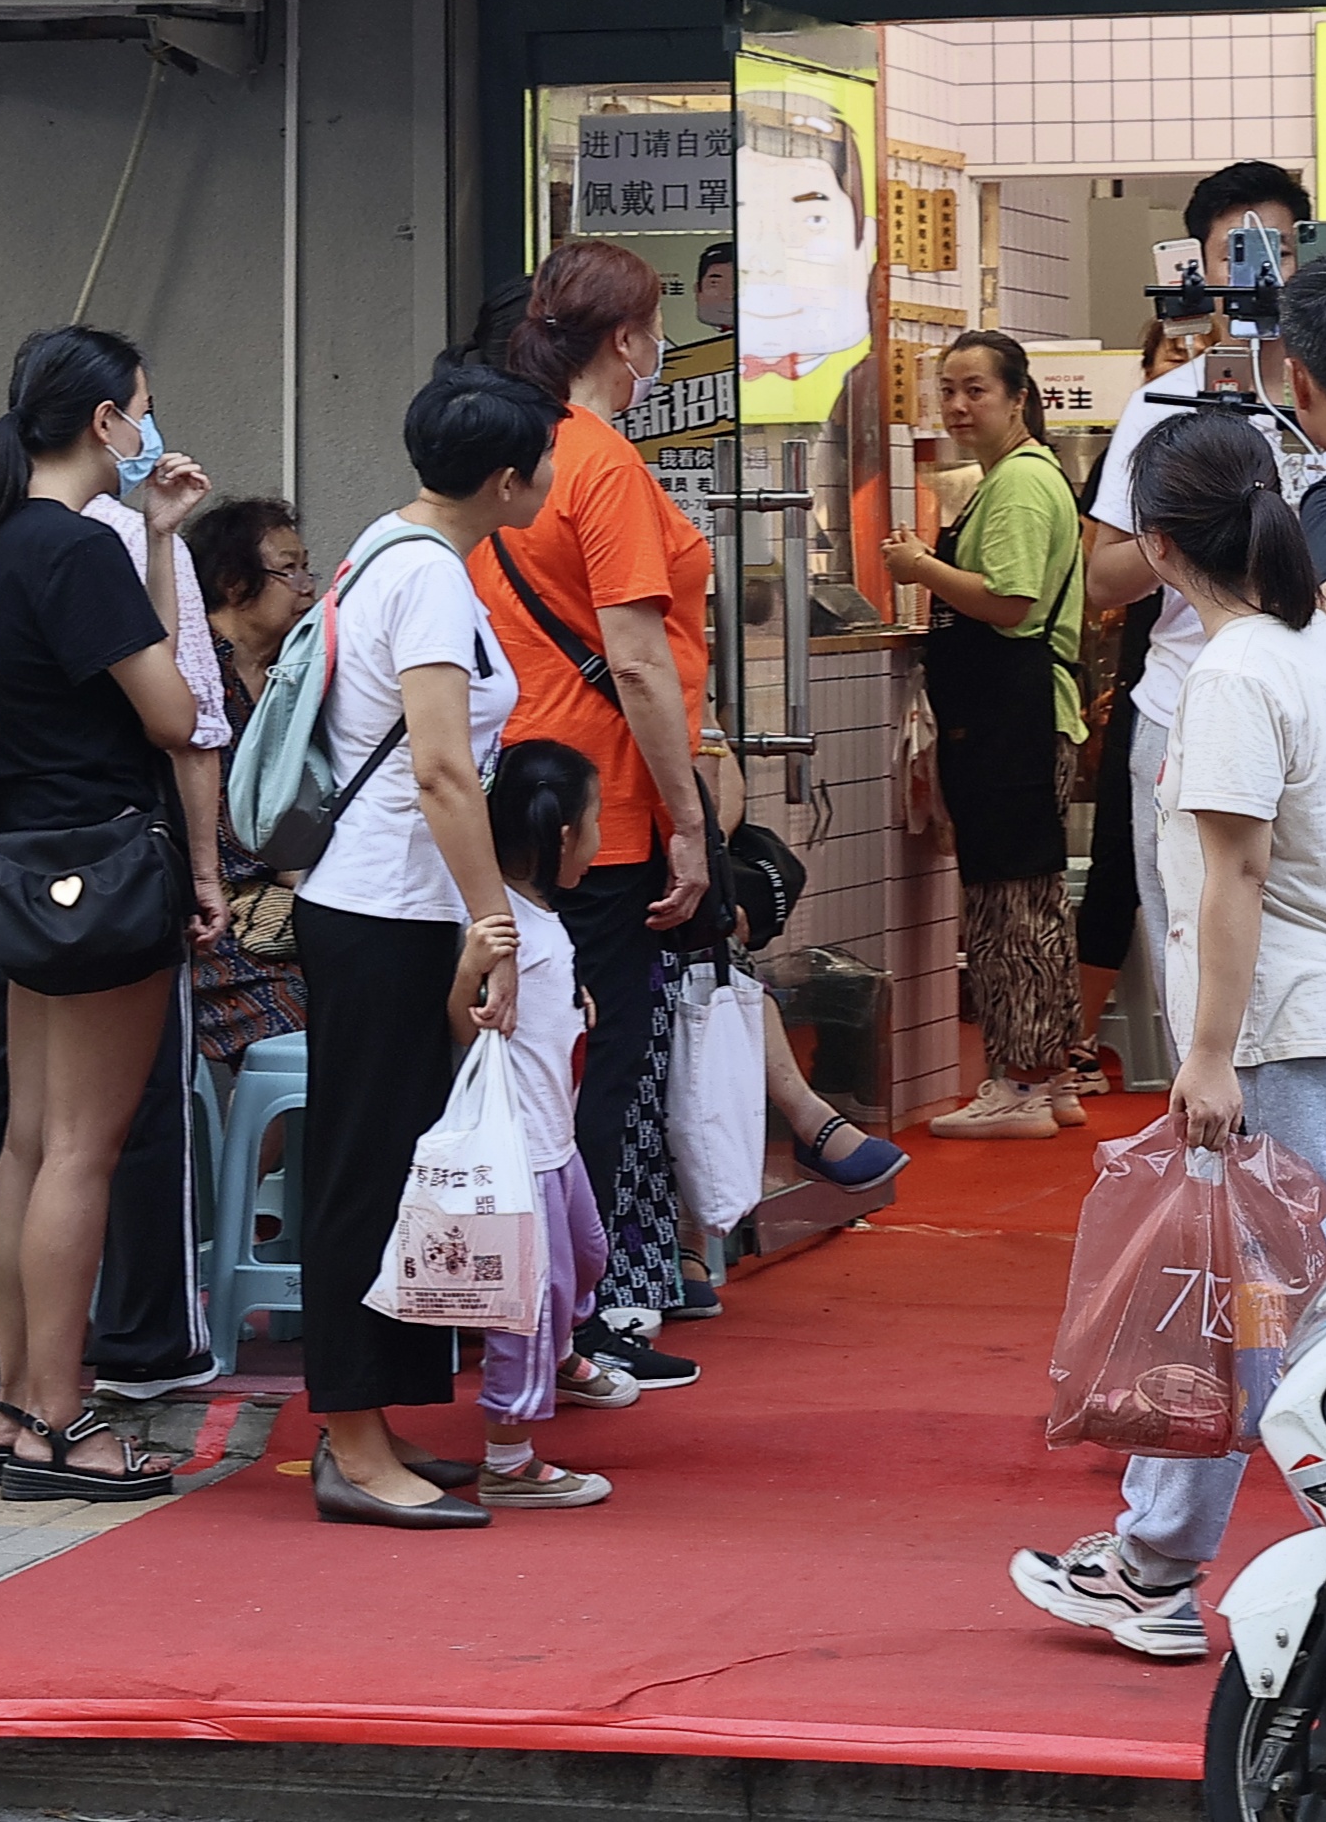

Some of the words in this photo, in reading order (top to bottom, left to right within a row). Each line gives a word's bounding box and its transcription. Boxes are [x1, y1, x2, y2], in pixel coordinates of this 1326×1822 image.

[581, 128, 733, 159] 进门请自觉
[582, 179, 731, 217] 佩戴口罩
